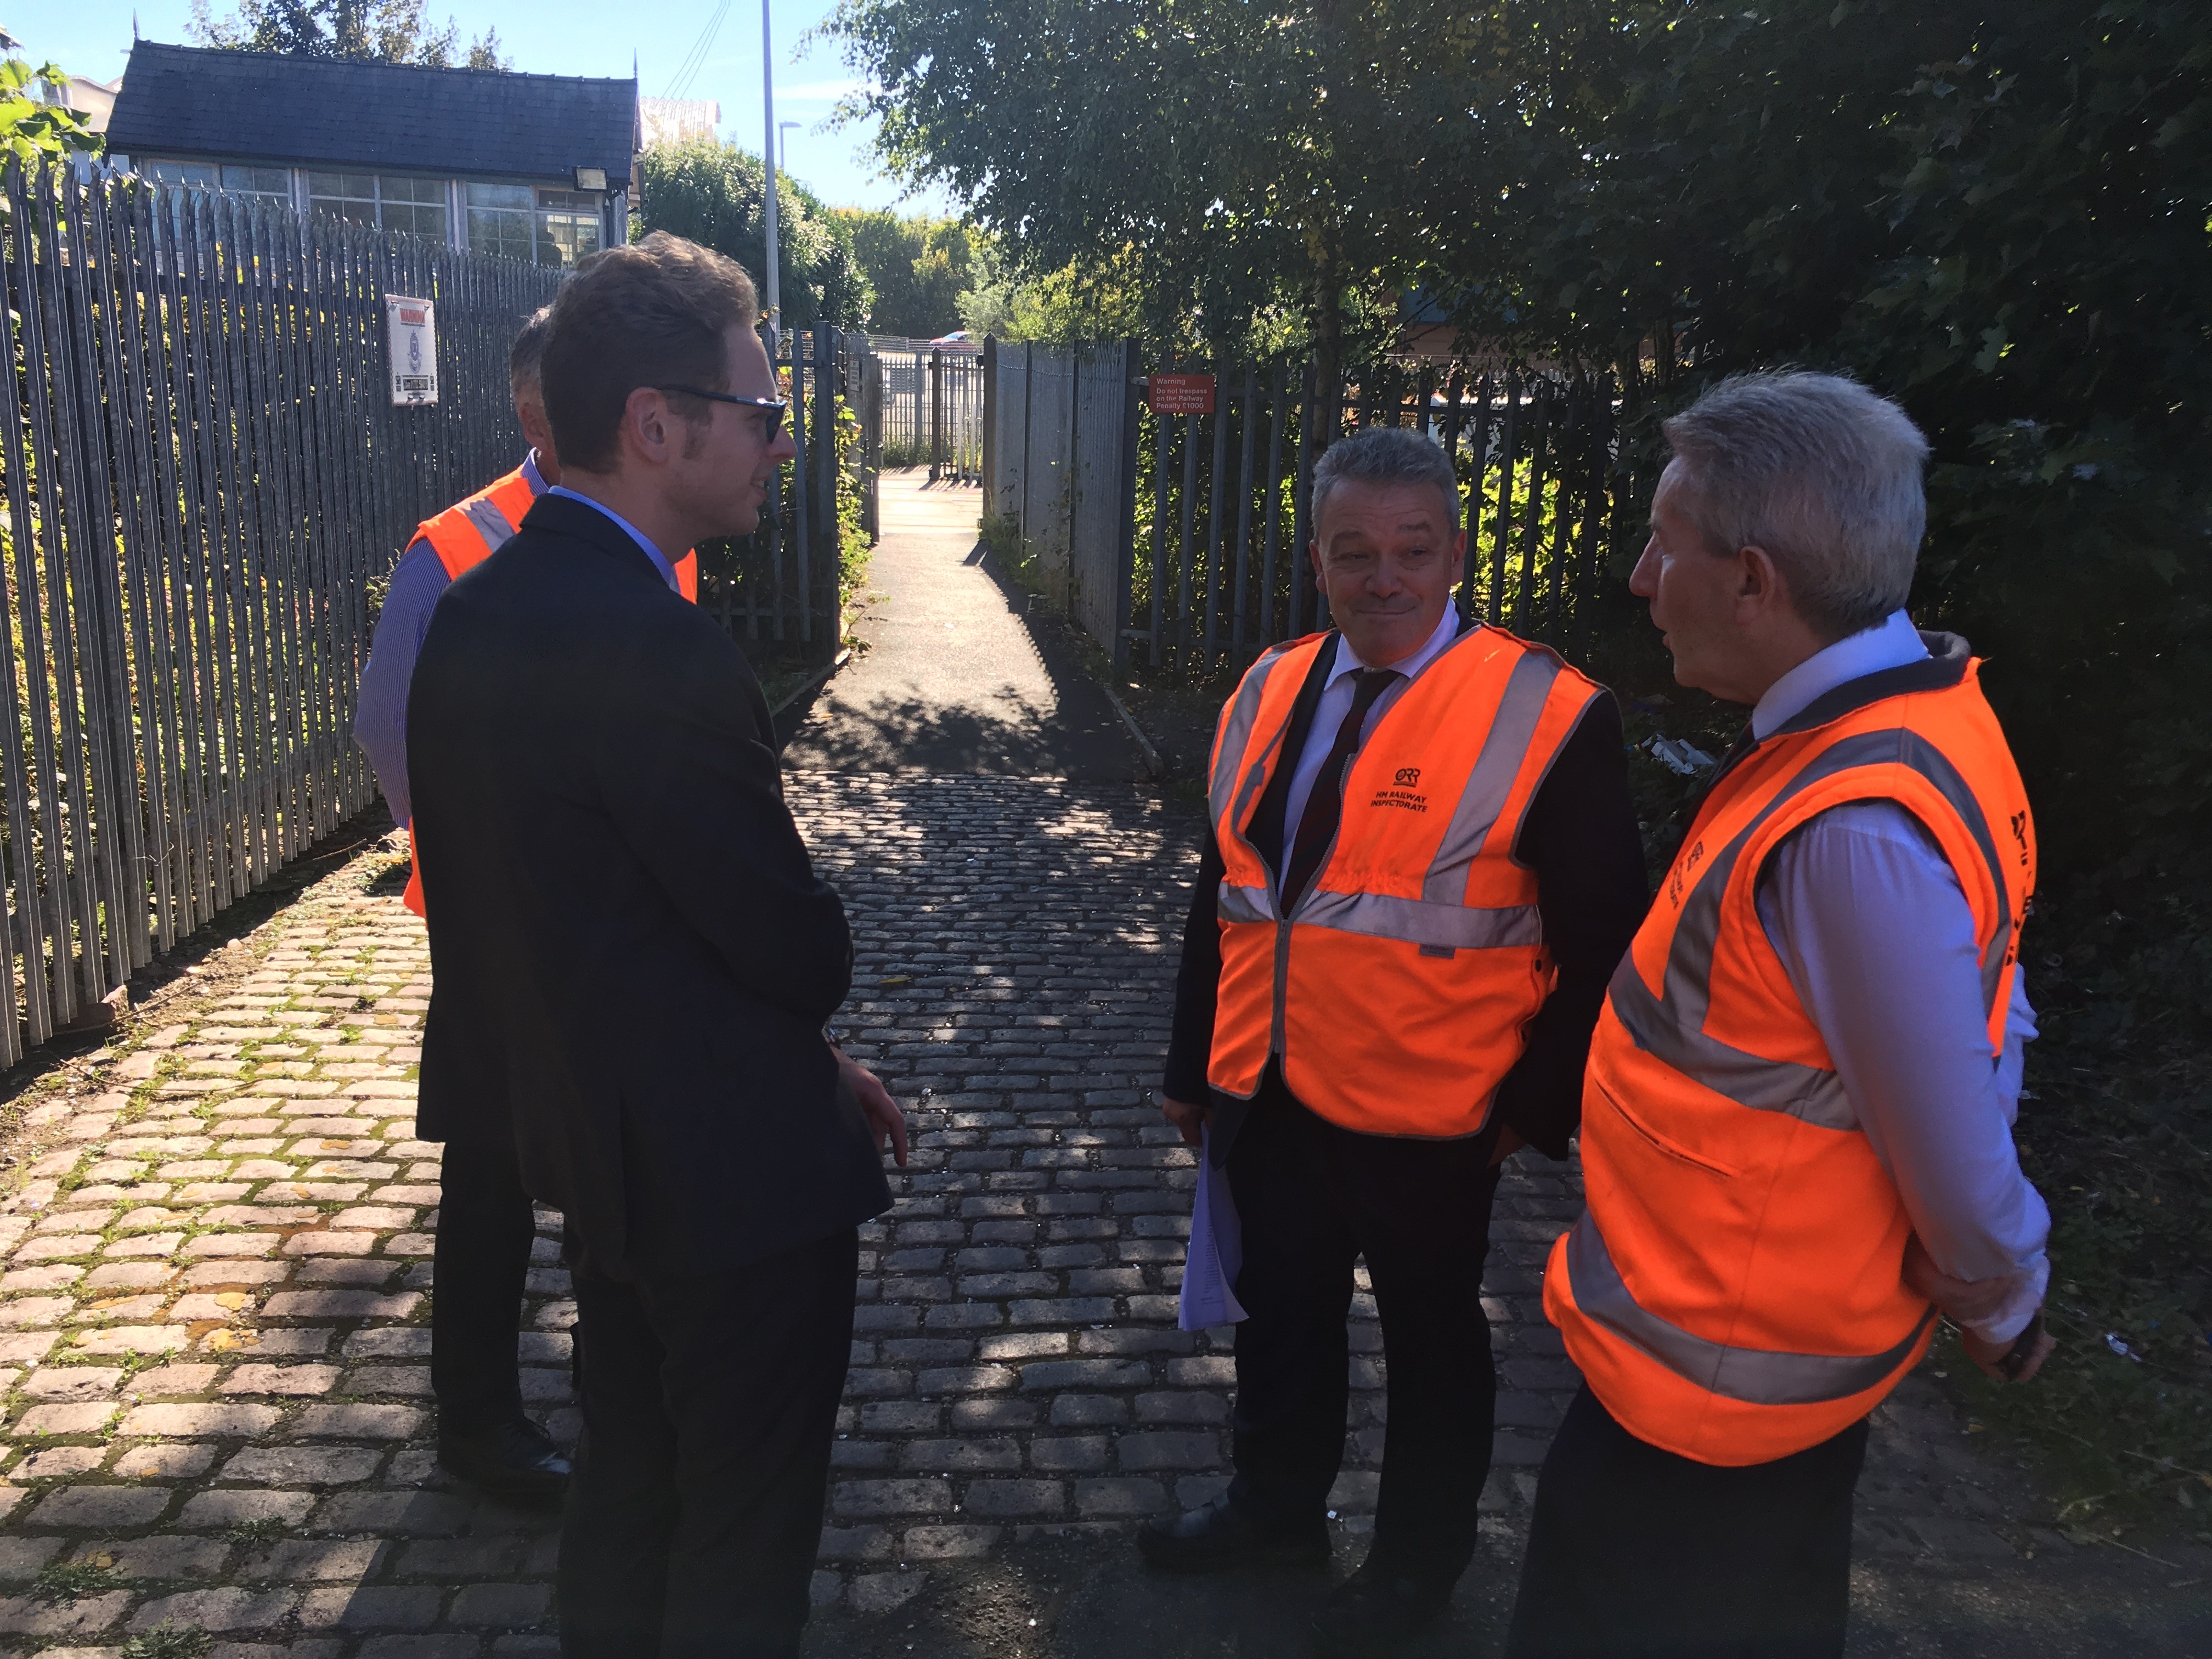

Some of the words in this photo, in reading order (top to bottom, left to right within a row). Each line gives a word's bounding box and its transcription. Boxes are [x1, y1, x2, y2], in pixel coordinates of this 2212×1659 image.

[1395, 768, 1421, 783] ORR
[1389, 791, 1427, 803] RAILWAY
[1370, 799, 1428, 812] INSPECTORATE
